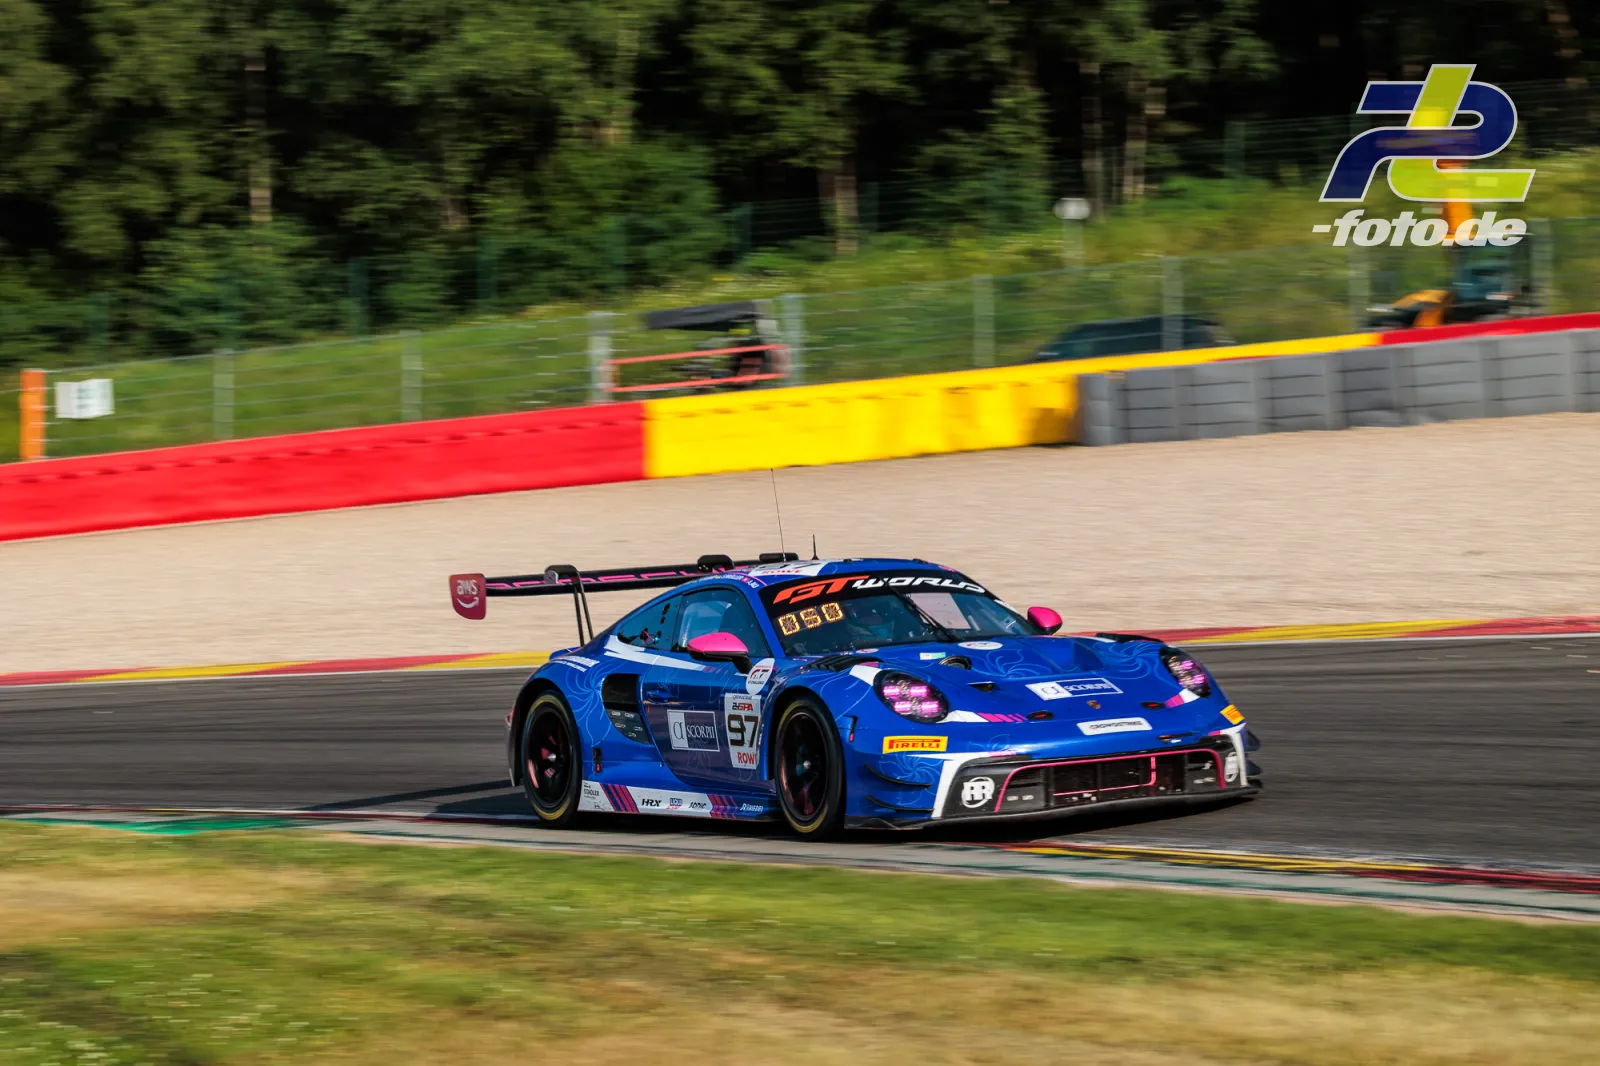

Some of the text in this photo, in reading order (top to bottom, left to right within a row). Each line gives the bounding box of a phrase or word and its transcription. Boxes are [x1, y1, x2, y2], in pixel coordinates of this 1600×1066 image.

[456, 579, 479, 596] aws
[772, 575, 871, 605] GT
[686, 724, 716, 739] SCORPII
[727, 714, 759, 749] 97
[888, 738, 941, 750] PIRELLI
[641, 798, 662, 807] HRX
